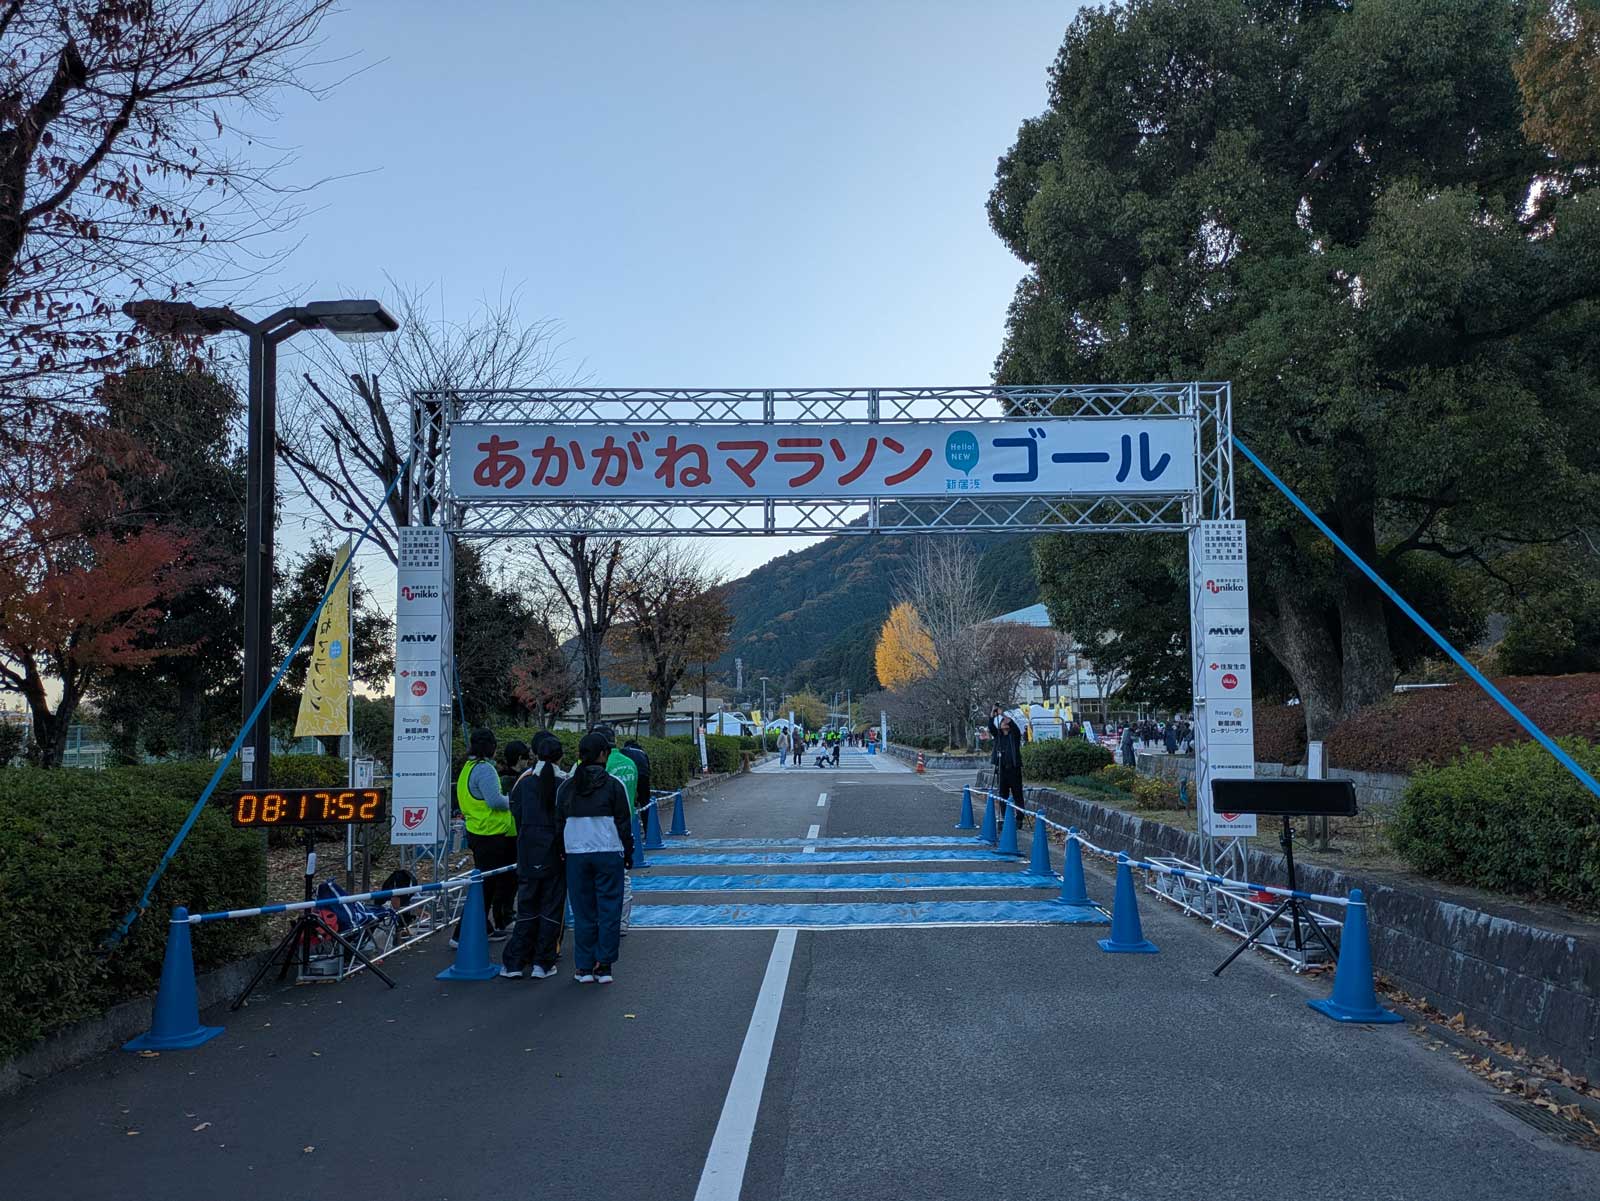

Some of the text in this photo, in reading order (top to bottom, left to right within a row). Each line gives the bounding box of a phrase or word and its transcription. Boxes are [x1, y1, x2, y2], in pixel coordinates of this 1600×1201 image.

[950, 443, 975, 451] Hello!
[473, 427, 1171, 489] あかがねマラソン ゴール
[945, 479, 981, 490] 新居浜
[238, 792, 377, 823] 08:17:52
